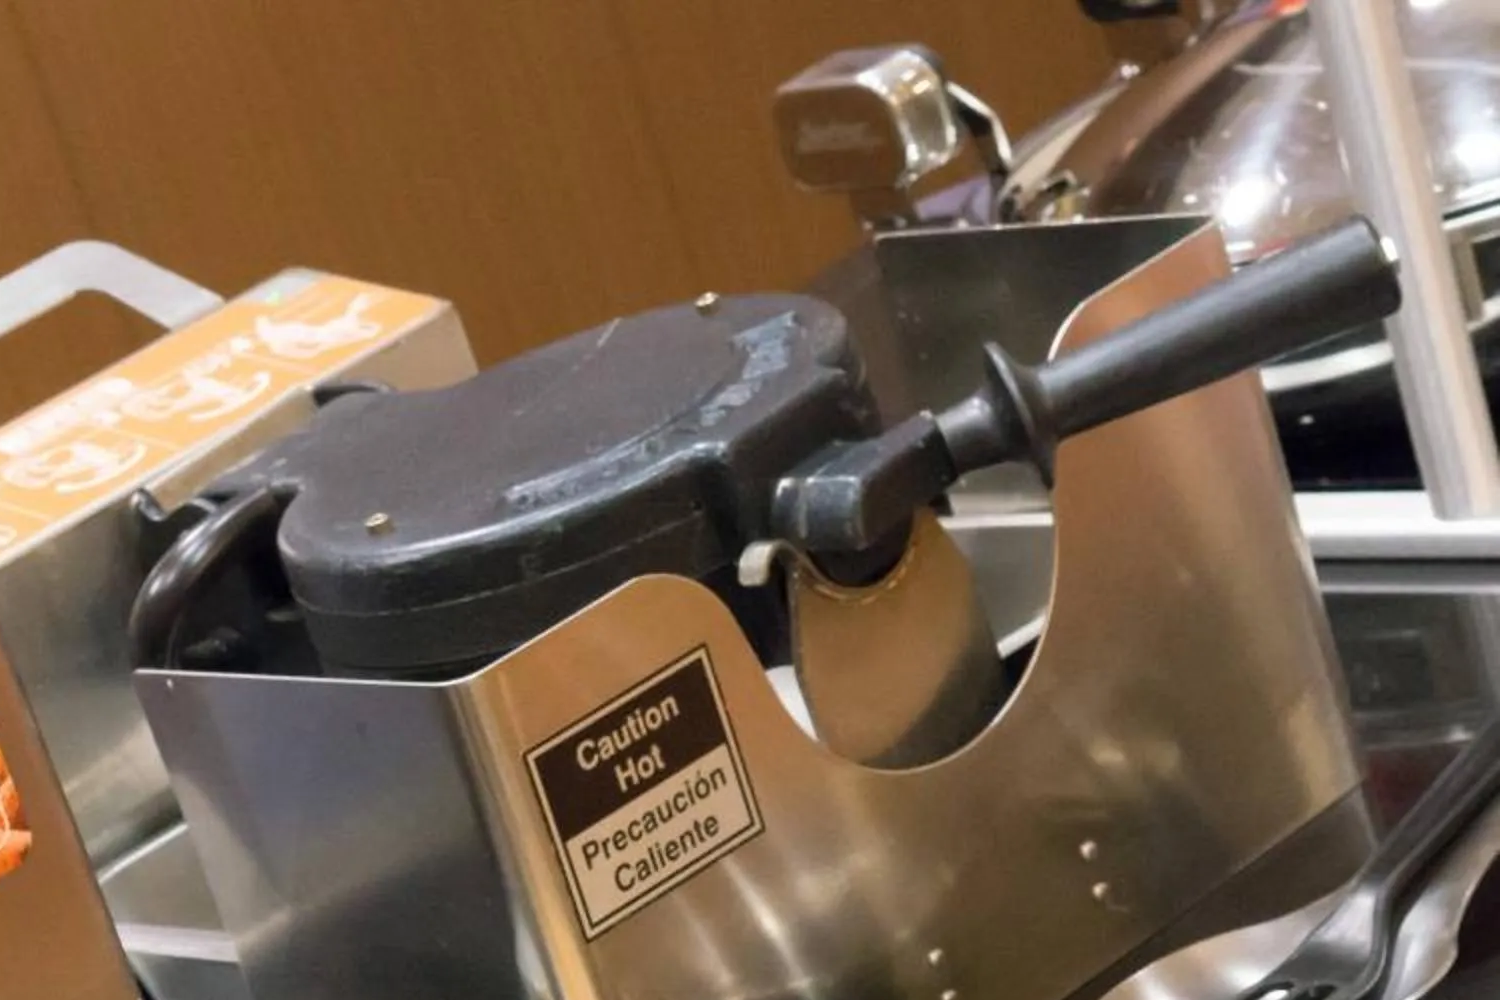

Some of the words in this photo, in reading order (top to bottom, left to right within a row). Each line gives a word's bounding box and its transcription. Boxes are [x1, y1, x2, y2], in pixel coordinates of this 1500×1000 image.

[576, 695, 680, 771] Caution
[614, 744, 666, 793] Hot
[581, 765, 727, 871] Precaución
[614, 815, 720, 893] Caliente
